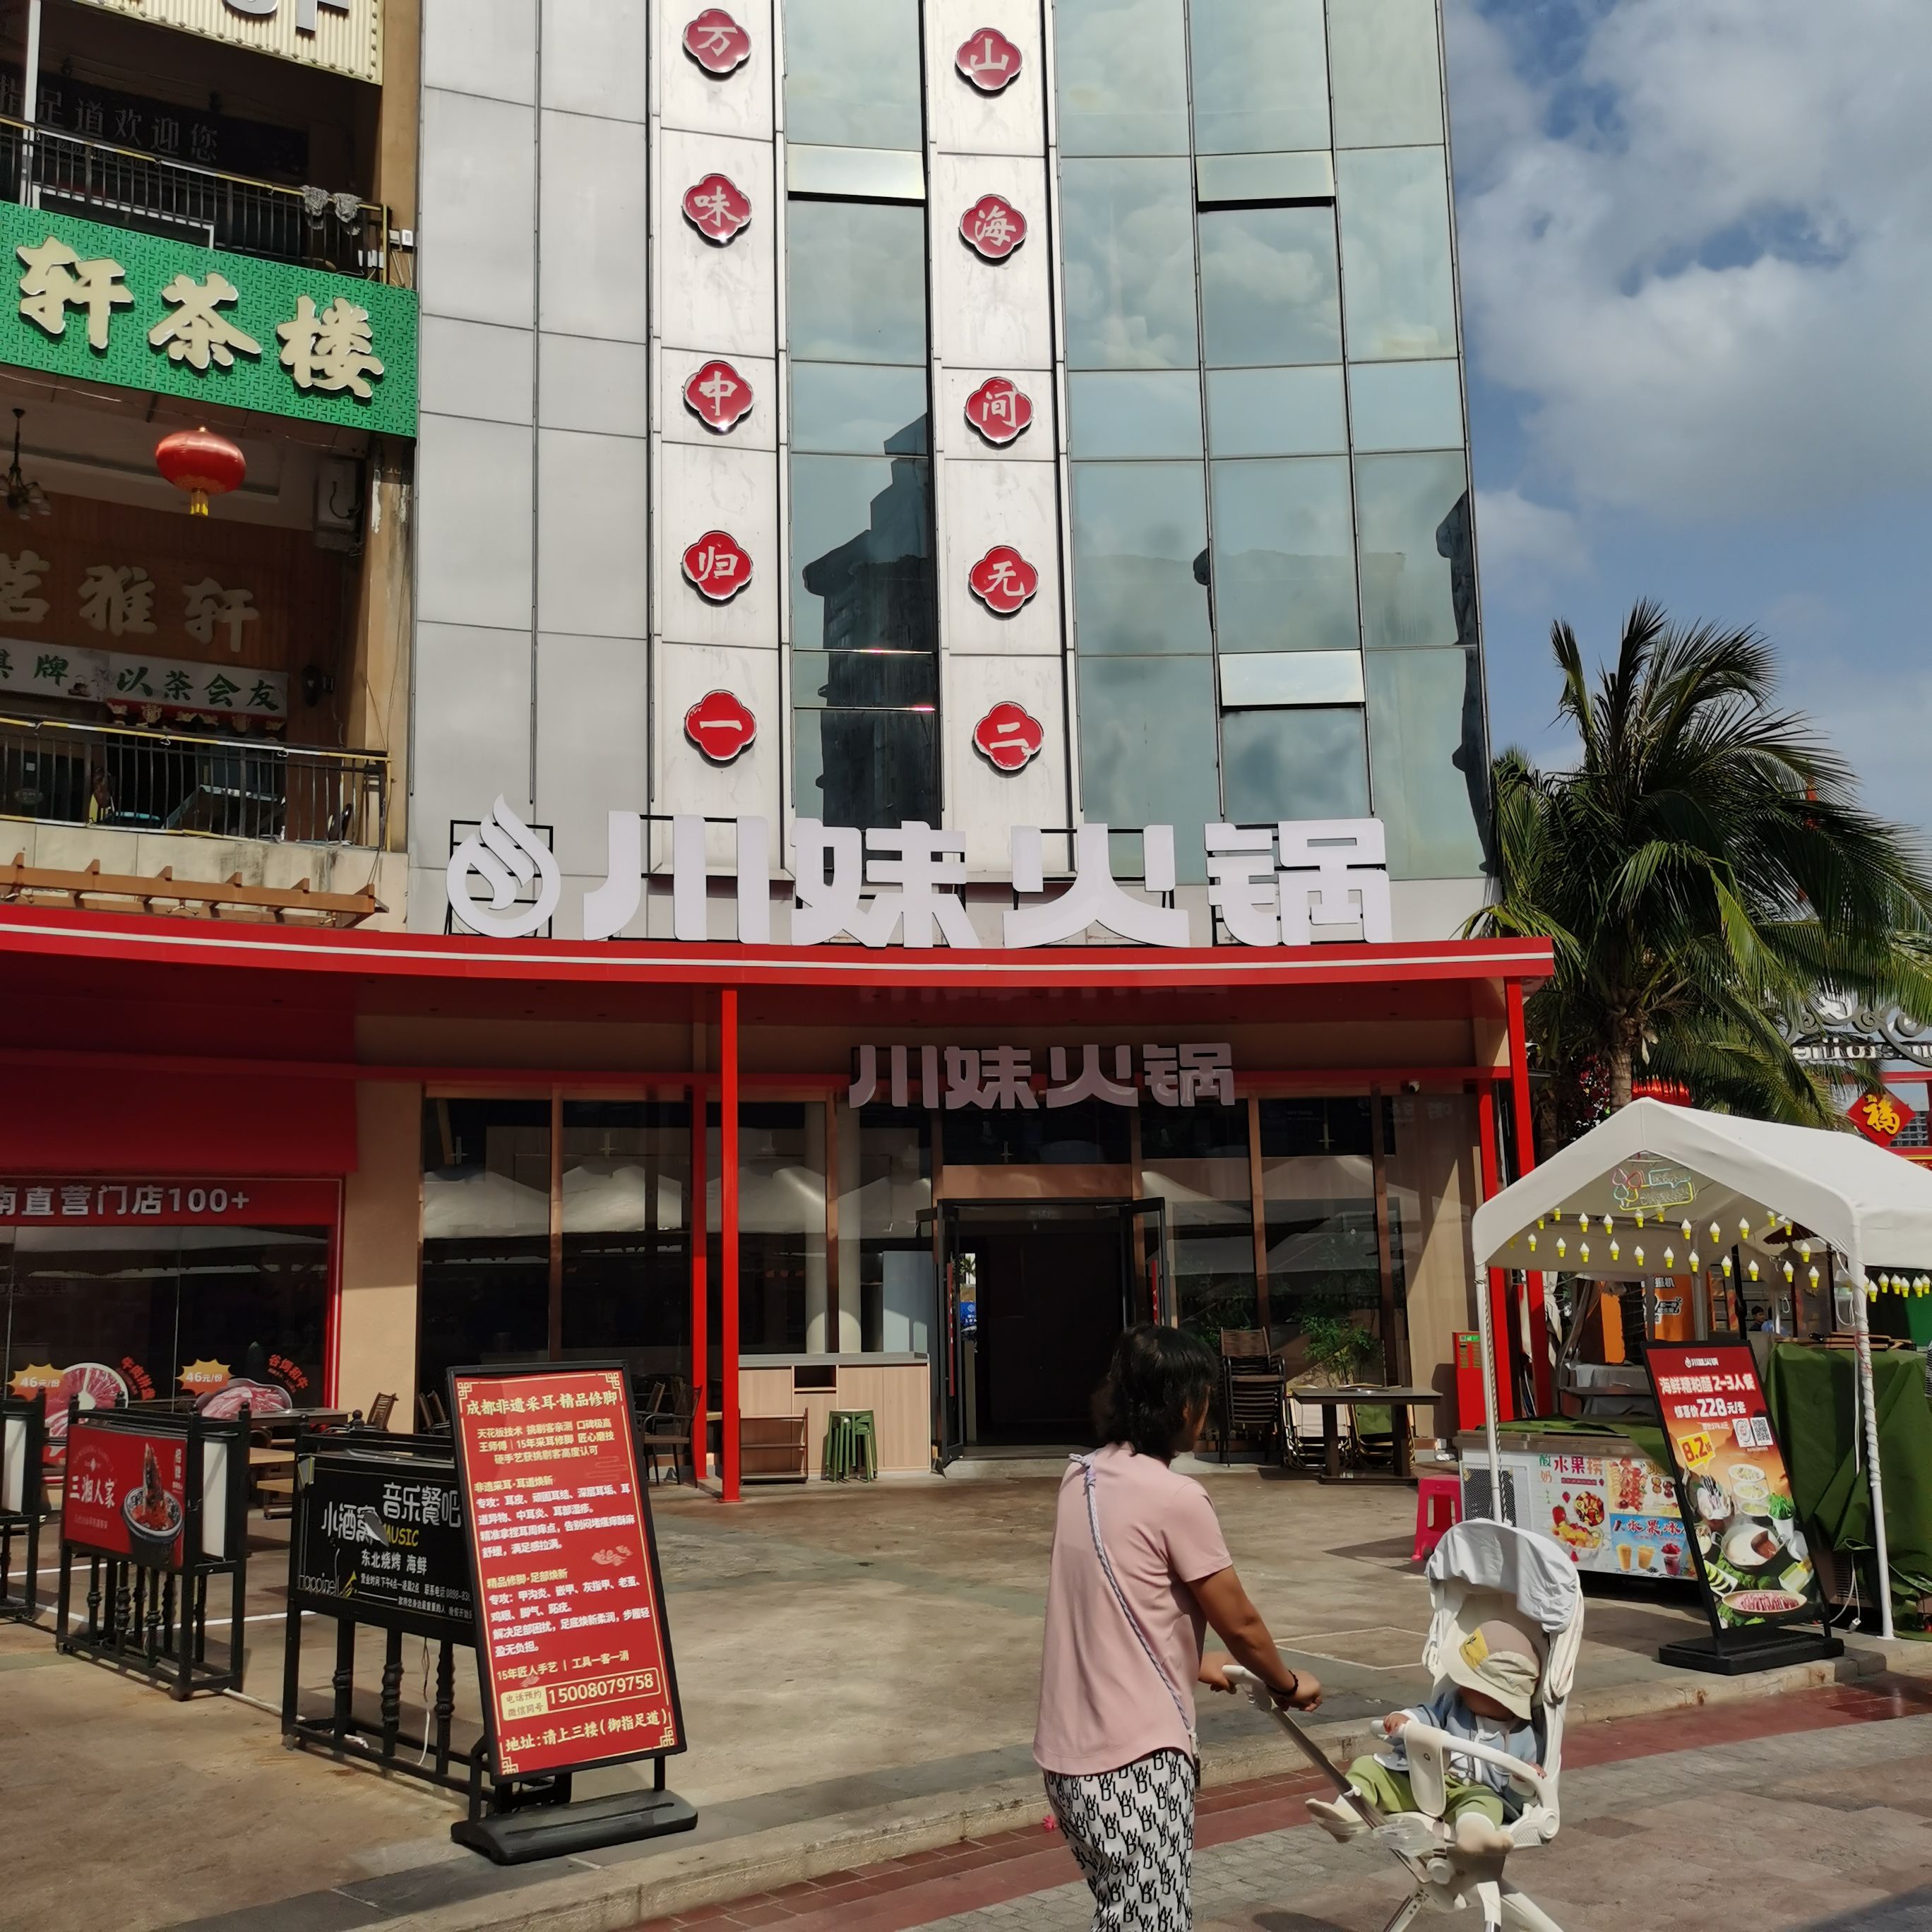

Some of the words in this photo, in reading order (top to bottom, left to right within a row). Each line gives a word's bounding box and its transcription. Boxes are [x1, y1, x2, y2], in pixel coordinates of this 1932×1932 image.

[16, 235, 384, 398] 轩茶楼
[117, 667, 279, 711] 以茶会友
[583, 810, 1393, 949] 川妹火锅
[849, 1043, 1235, 1109] 川妹火锅
[1863, 1094, 1901, 1135] 福
[185, 1371, 223, 1383] 46元/份
[477, 1426, 523, 1438] 天花板技术
[576, 1418, 612, 1430] 口碑极高
[479, 1441, 507, 1452] 王师傅
[70, 1474, 114, 1508] 三湘人家
[383, 1482, 461, 1527] 音乐餐吧
[385, 1524, 419, 1546] MUSIC
[362, 1549, 401, 1571] 东北烧烤
[407, 1554, 427, 1575] 海鲜
[497, 1661, 559, 1681] 15年匠人手艺
[572, 1650, 630, 1669] 工具一客一消
[506, 1690, 542, 1703] 电话预约
[548, 1674, 654, 1705] 15008079758
[508, 1703, 544, 1717] 微信同号
